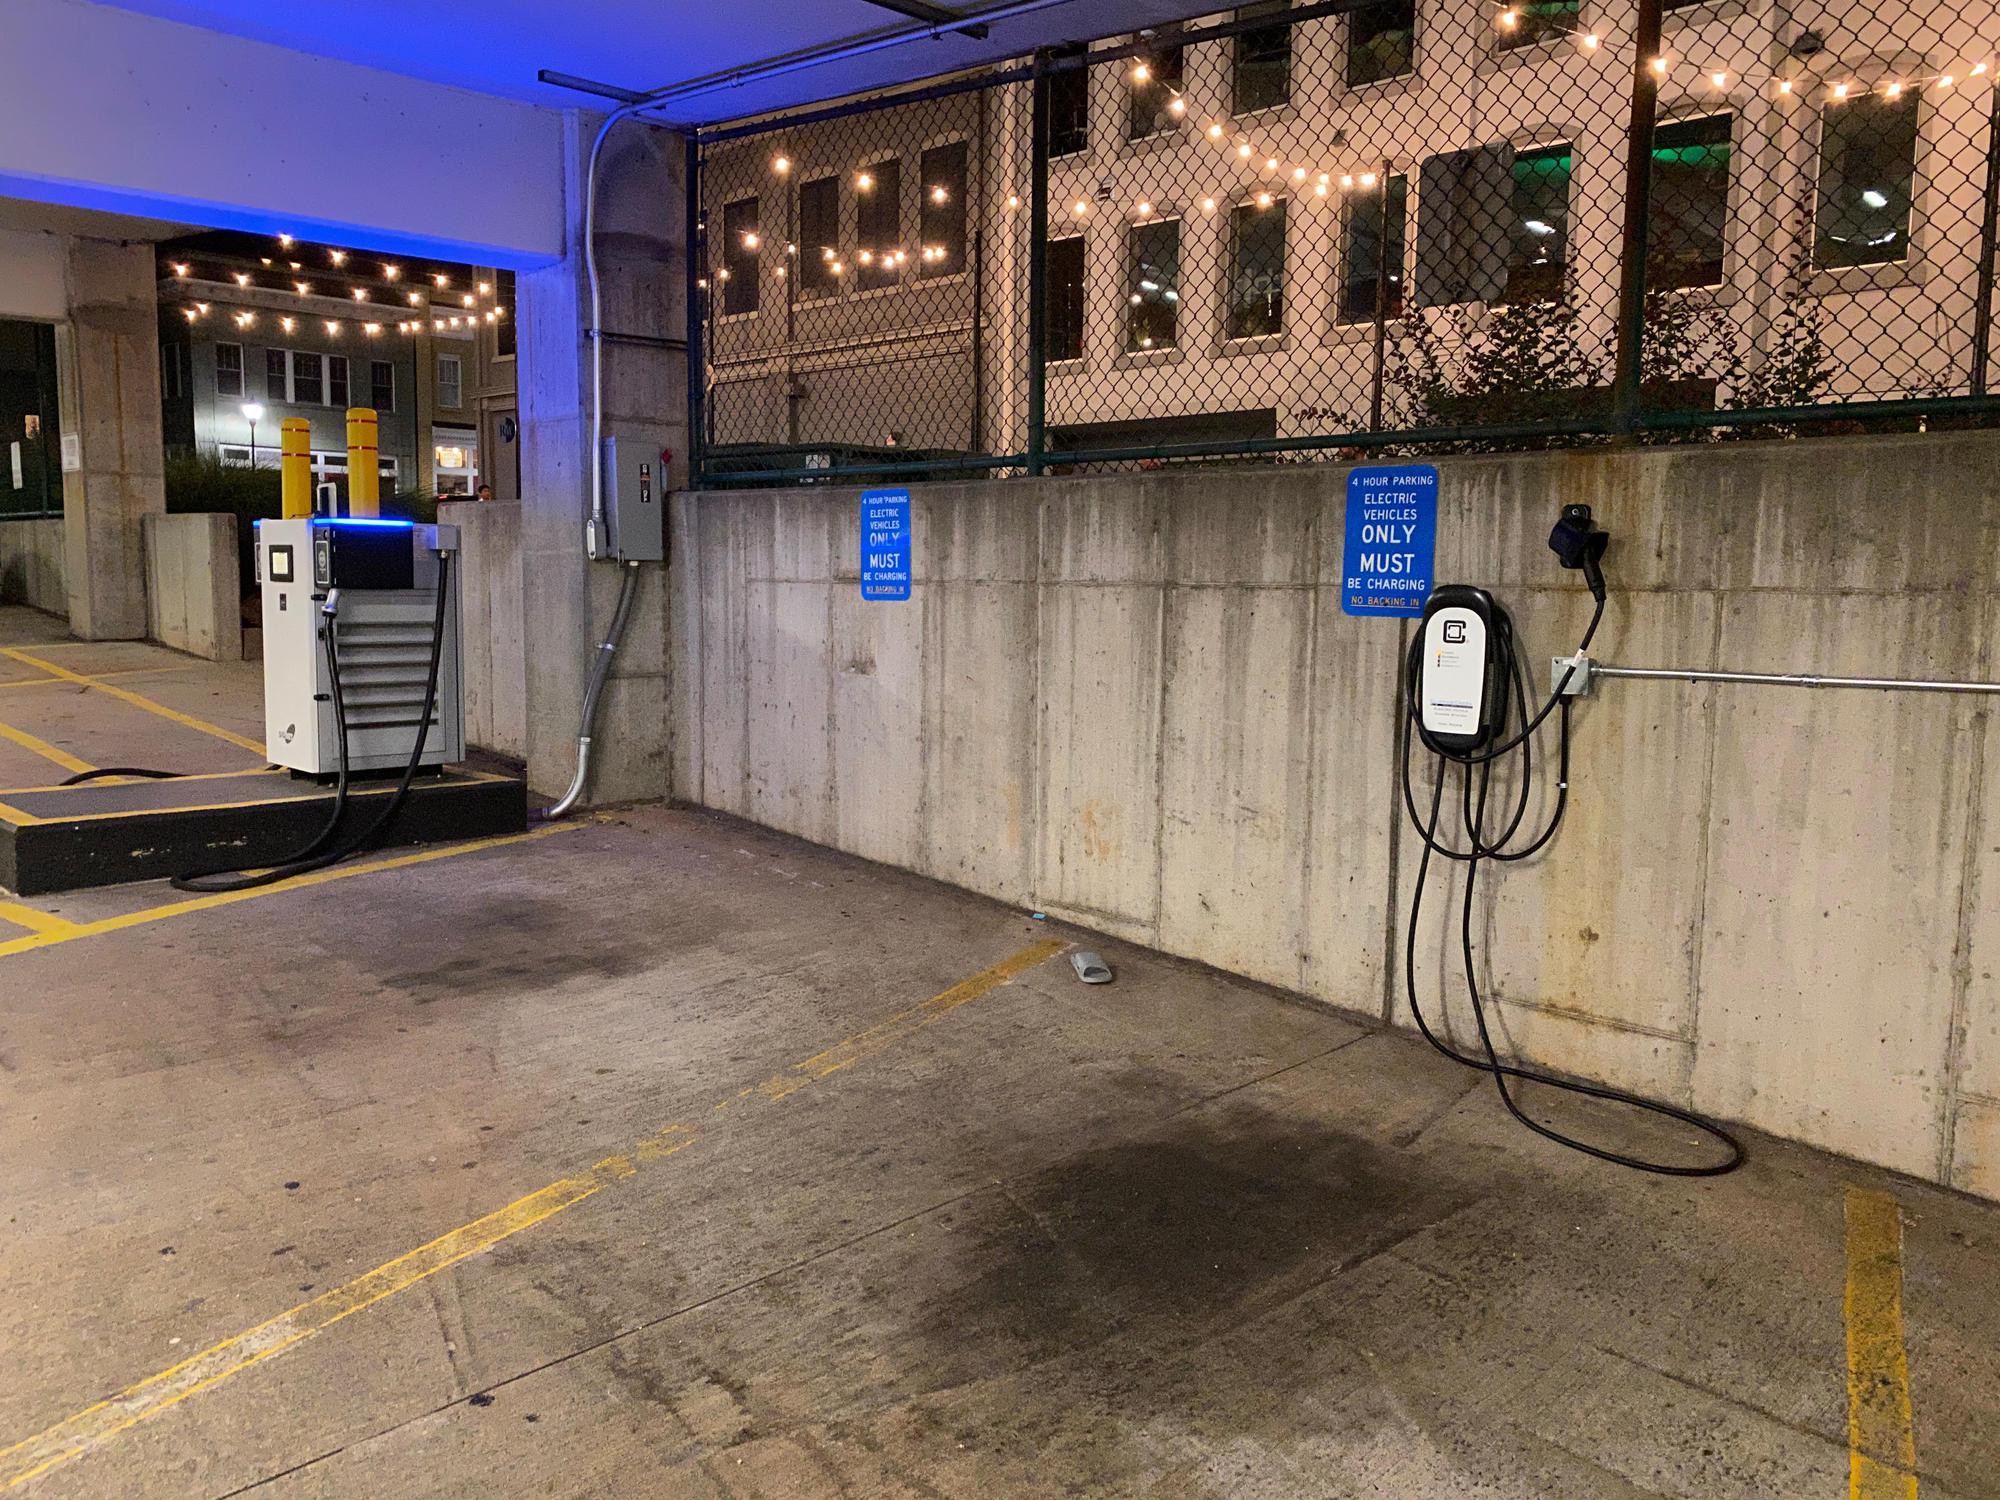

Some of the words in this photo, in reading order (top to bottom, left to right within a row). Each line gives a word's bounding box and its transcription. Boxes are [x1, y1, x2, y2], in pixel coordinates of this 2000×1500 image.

[1352, 477, 1358, 487] 4
[1363, 477, 1388, 486] HOUR
[1393, 475, 1433, 486] PARKING
[869, 497, 883, 505] HOUR
[884, 495, 908, 504] PARKING
[1364, 492, 1417, 504] ELECTRIC
[870, 508, 899, 518] ELECTRIC
[1364, 509, 1417, 521] VEHICLES
[870, 520, 900, 530] VEHICLES
[869, 532, 900, 547] ONLY
[1361, 524, 1416, 544] ONLY
[869, 553, 900, 569] MUST
[1360, 553, 1415, 573] MUST
[863, 572, 872, 581] BE
[875, 572, 907, 581] CHARGING
[1347, 577, 1361, 589] BE
[1367, 578, 1425, 591] CHARGING
[1351, 595, 1363, 605] NO
[1368, 596, 1406, 607] BACKING
[1410, 597, 1419, 606] IN
